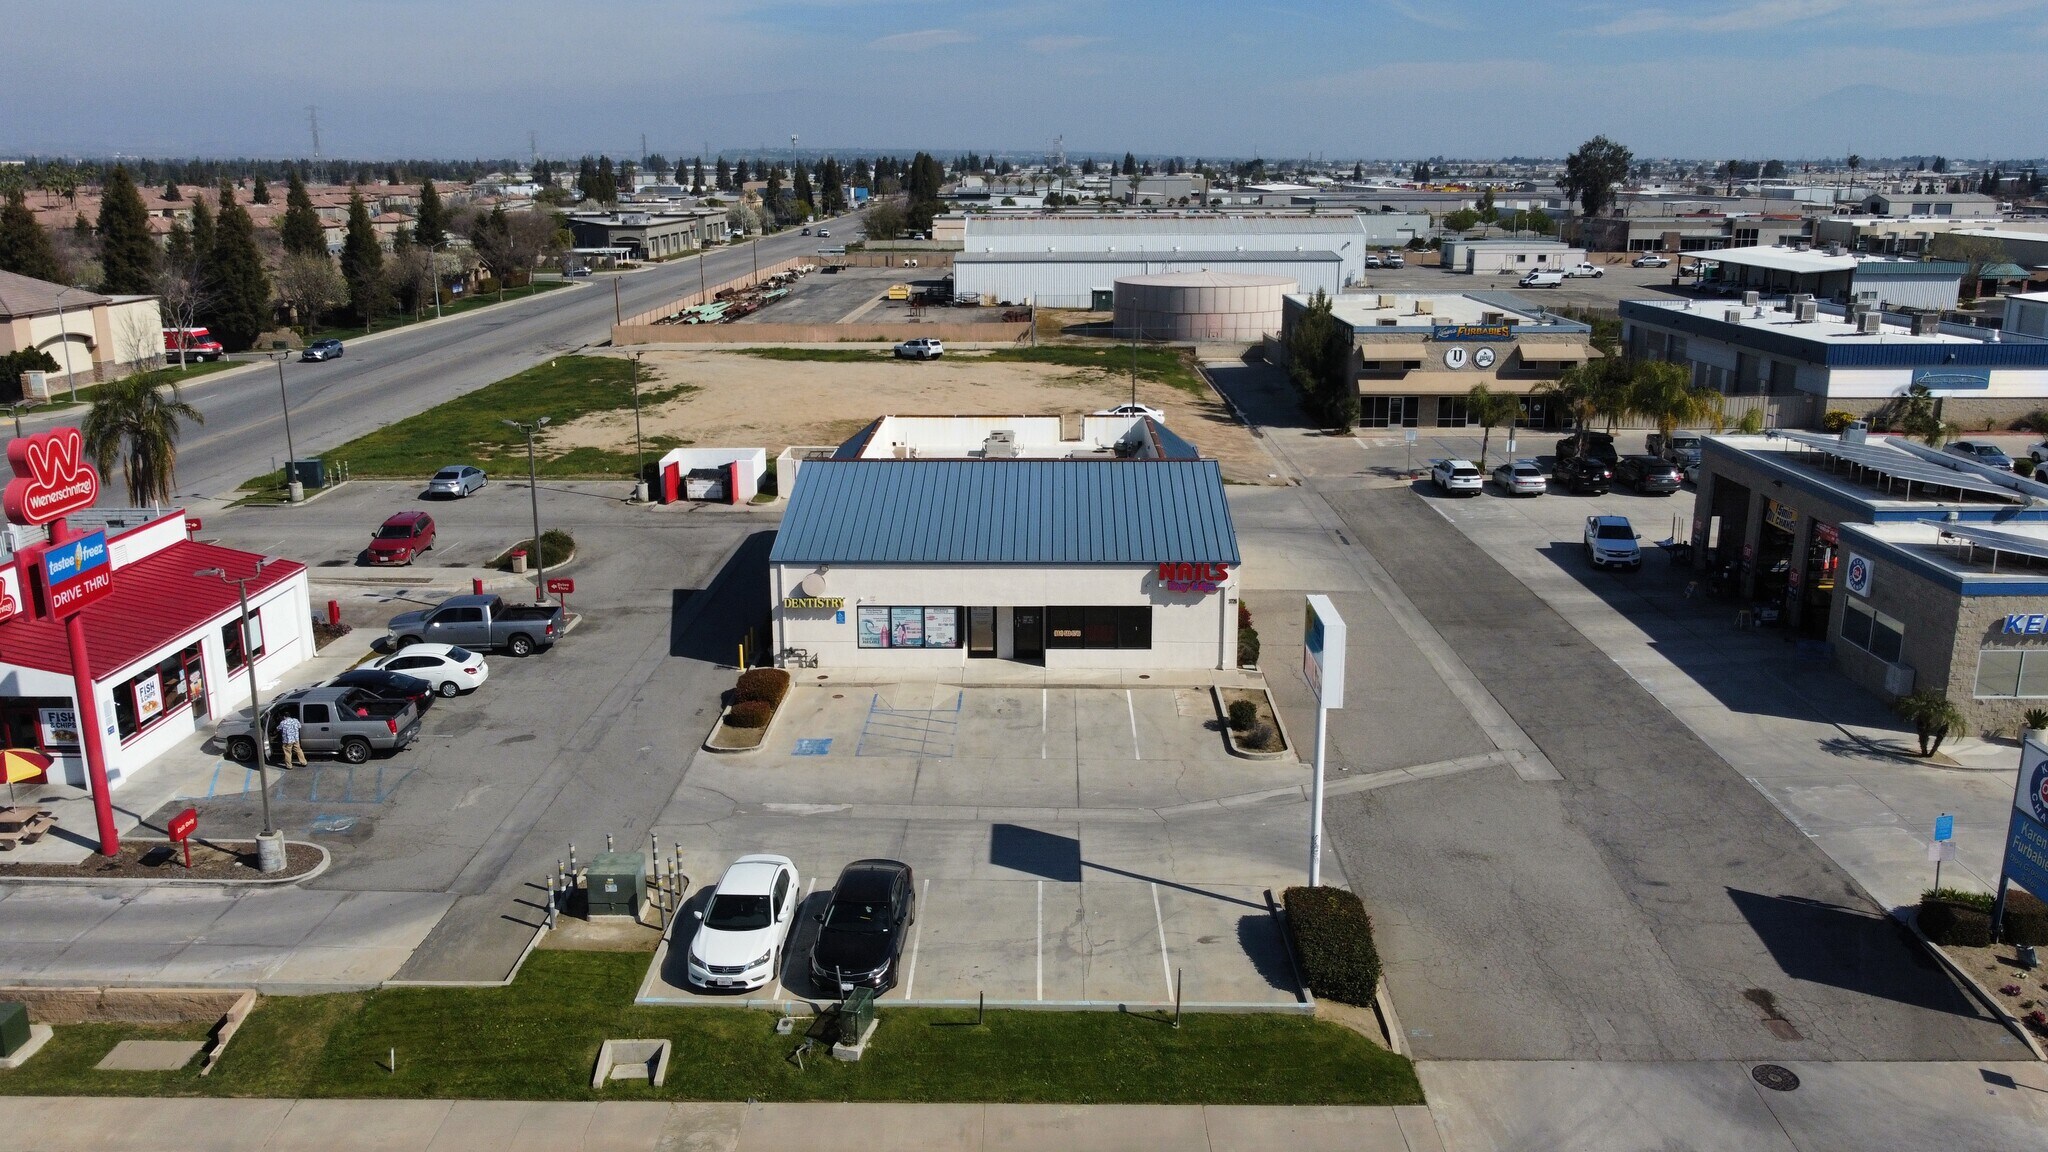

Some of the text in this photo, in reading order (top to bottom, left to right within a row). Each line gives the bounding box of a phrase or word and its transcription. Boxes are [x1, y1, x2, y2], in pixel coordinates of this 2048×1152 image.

[1457, 325, 1509, 337] FURBABIES
[30, 479, 91, 509] Wienerschnitzel
[49, 543, 104, 575] tastee freez
[1159, 563, 1229, 581] NAILS
[53, 572, 110, 608] DRIVE THRU
[783, 597, 845, 609] DENTISTRY
[139, 680, 155, 697] FISH
[48, 712, 75, 722] FISH
